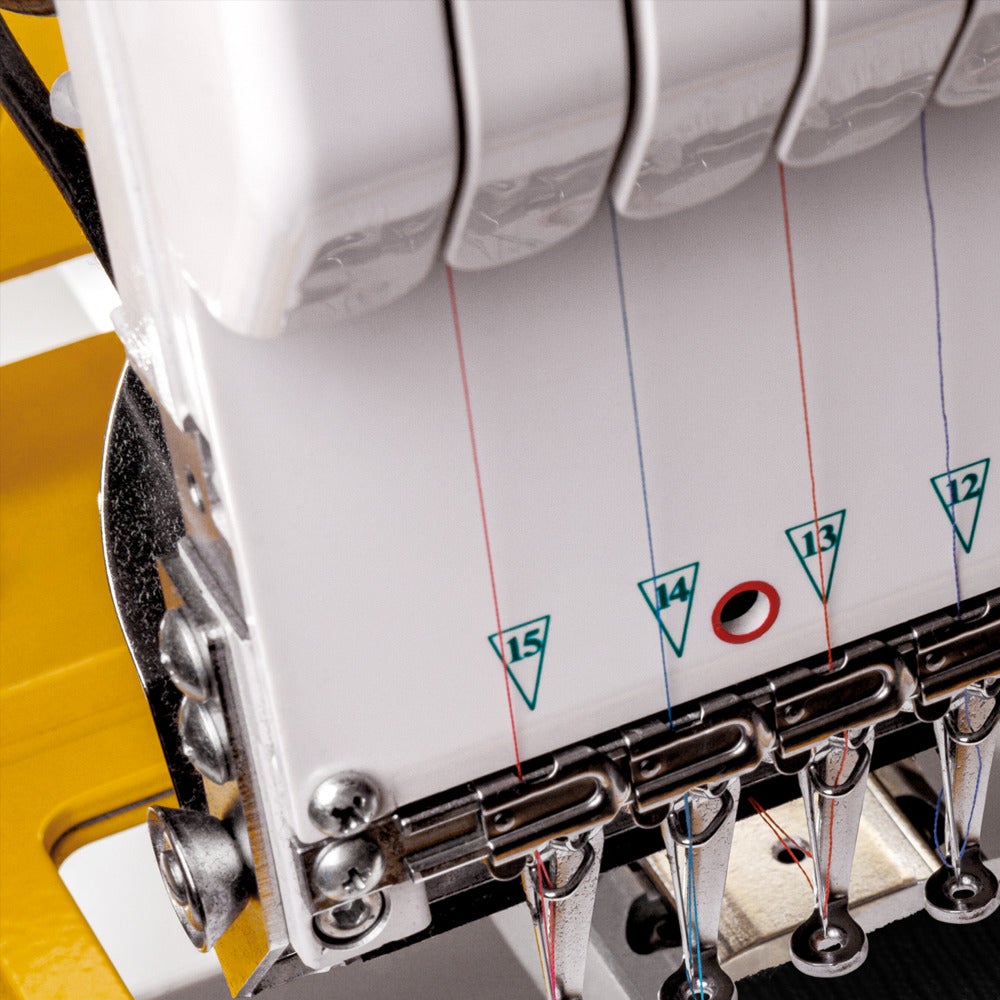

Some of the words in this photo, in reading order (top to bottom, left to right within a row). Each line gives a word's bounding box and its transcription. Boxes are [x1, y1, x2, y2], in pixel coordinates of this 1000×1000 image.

[947, 472, 981, 506] 12
[802, 523, 837, 559] 13
[655, 575, 690, 610] 14
[507, 627, 543, 663] 15
